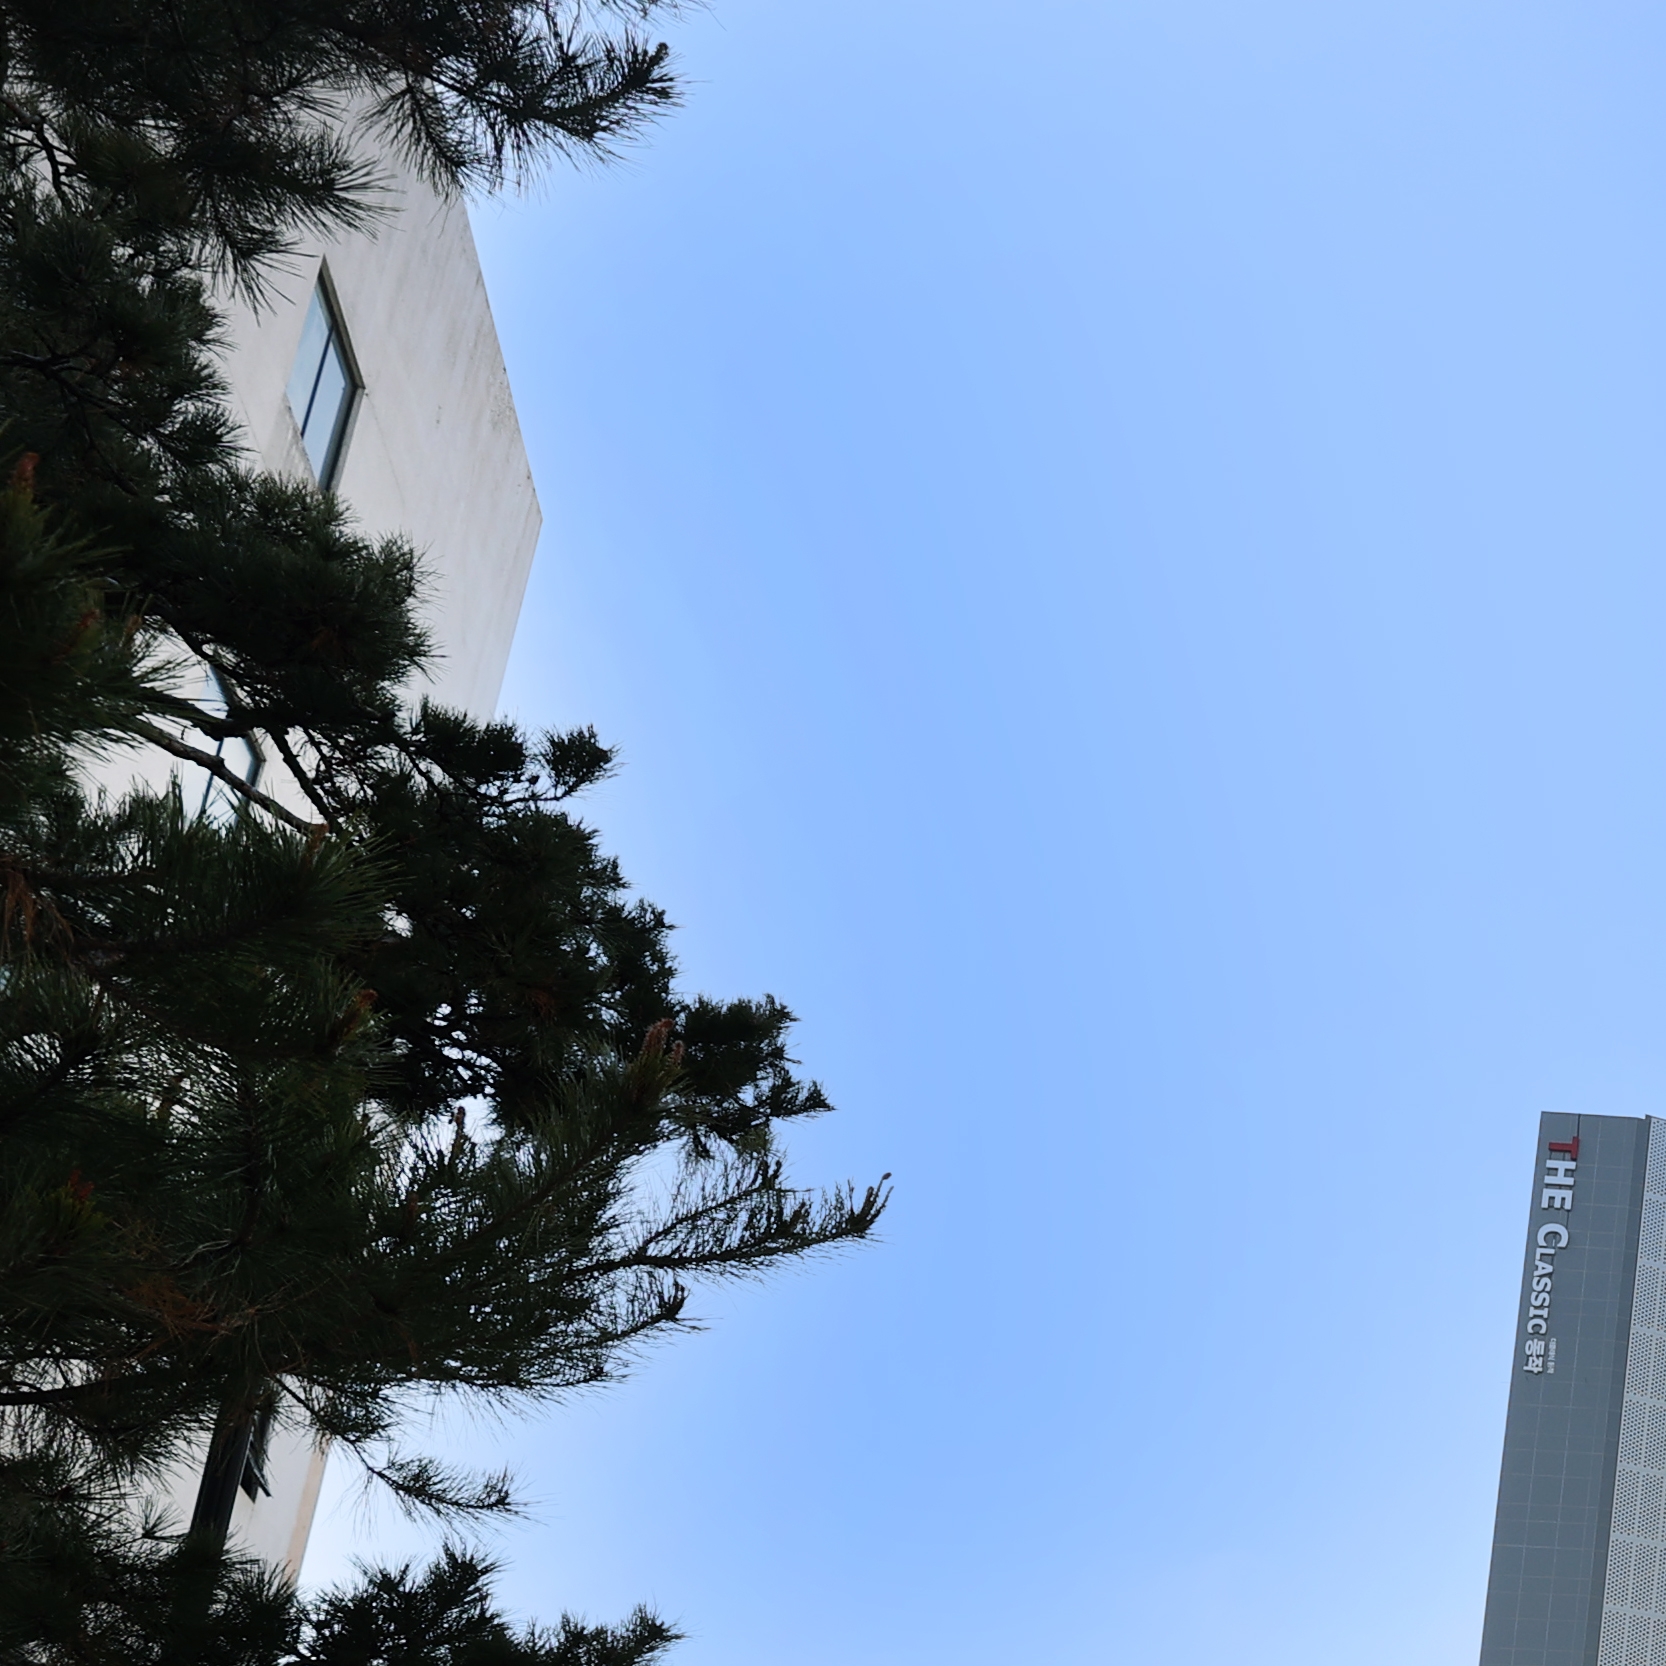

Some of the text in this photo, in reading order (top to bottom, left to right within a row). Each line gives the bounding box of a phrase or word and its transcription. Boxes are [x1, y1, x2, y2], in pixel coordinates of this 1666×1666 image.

[1527, 1136, 1580, 1335] THE CLASSIC
[1522, 1338, 1546, 1374] 동작
